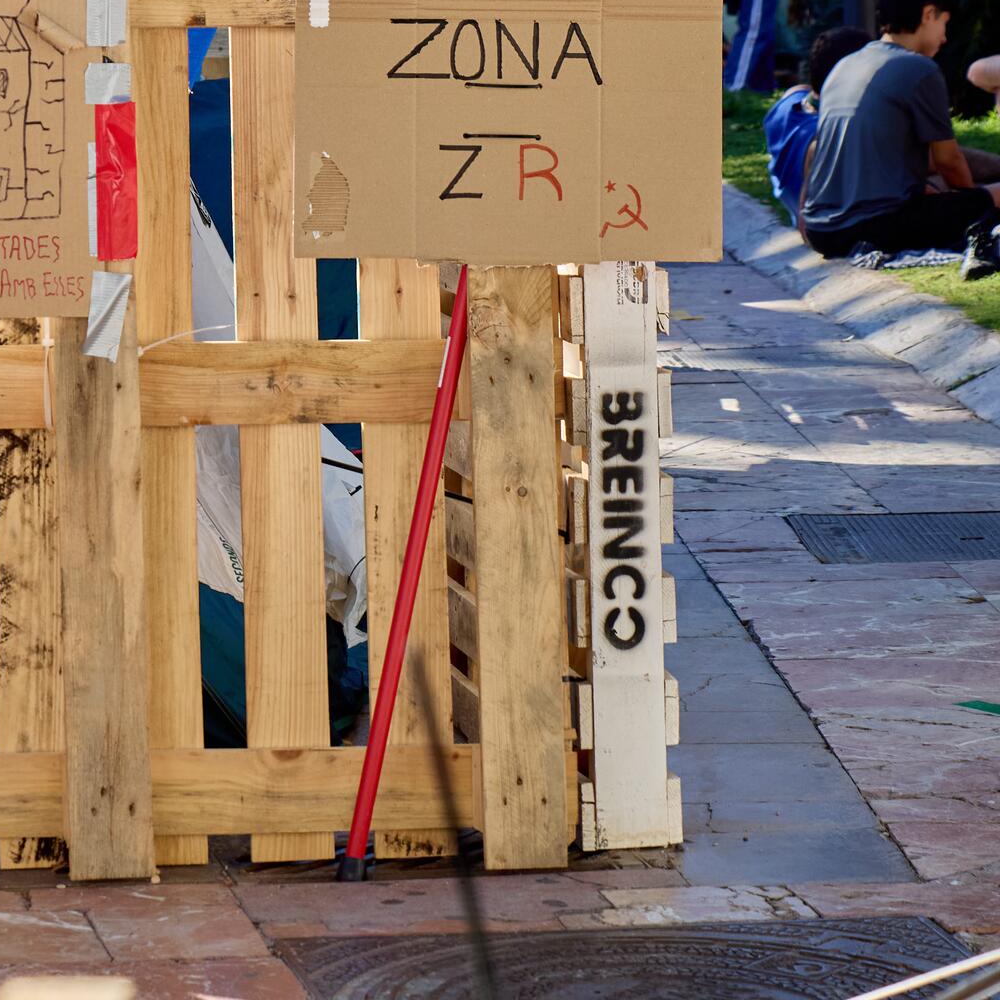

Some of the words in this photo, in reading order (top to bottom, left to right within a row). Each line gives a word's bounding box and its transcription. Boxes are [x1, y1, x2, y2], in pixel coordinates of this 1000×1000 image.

[387, 18, 603, 86] ZONA
[439, 144, 483, 201] Z
[518, 144, 563, 202] R
[0, 268, 37, 301] AMB
